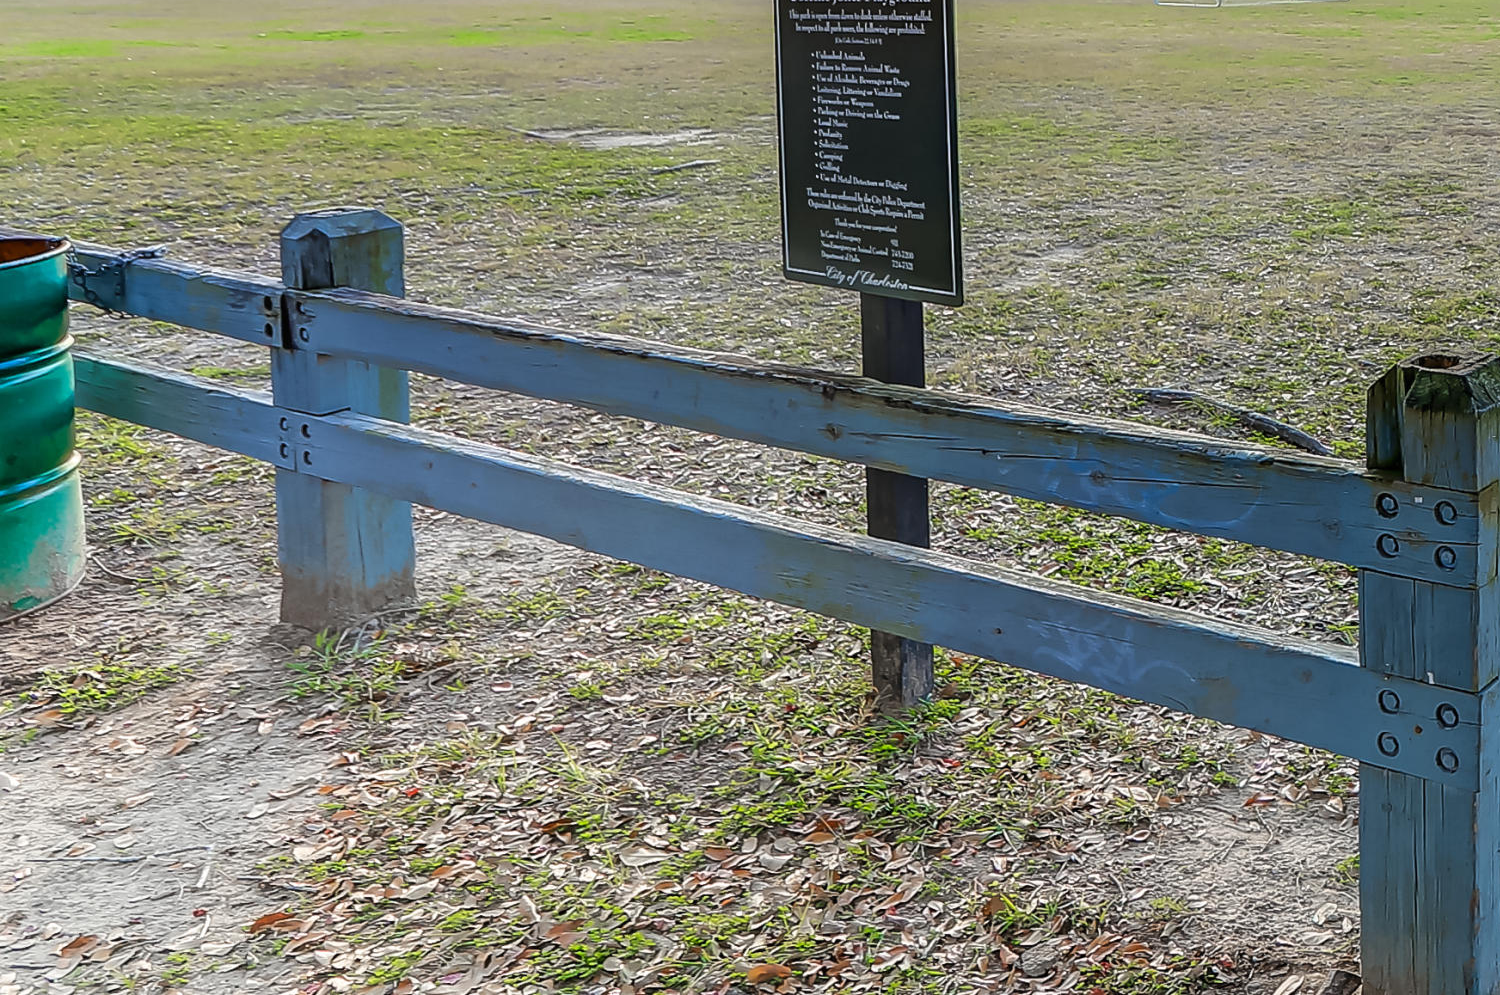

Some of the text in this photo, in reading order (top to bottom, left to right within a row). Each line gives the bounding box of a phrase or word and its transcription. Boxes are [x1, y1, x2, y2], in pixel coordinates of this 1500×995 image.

[859, 75, 886, 86] Beverages
[893, 77, 911, 88] Drugs
[846, 108, 866, 119] Driving
[837, 174, 852, 184] Metal
[853, 176, 878, 187] Detectors
[885, 179, 908, 191] Digging
[871, 195, 882, 207] City
[882, 195, 896, 206] Police
[825, 265, 908, 291] City of Charleston
